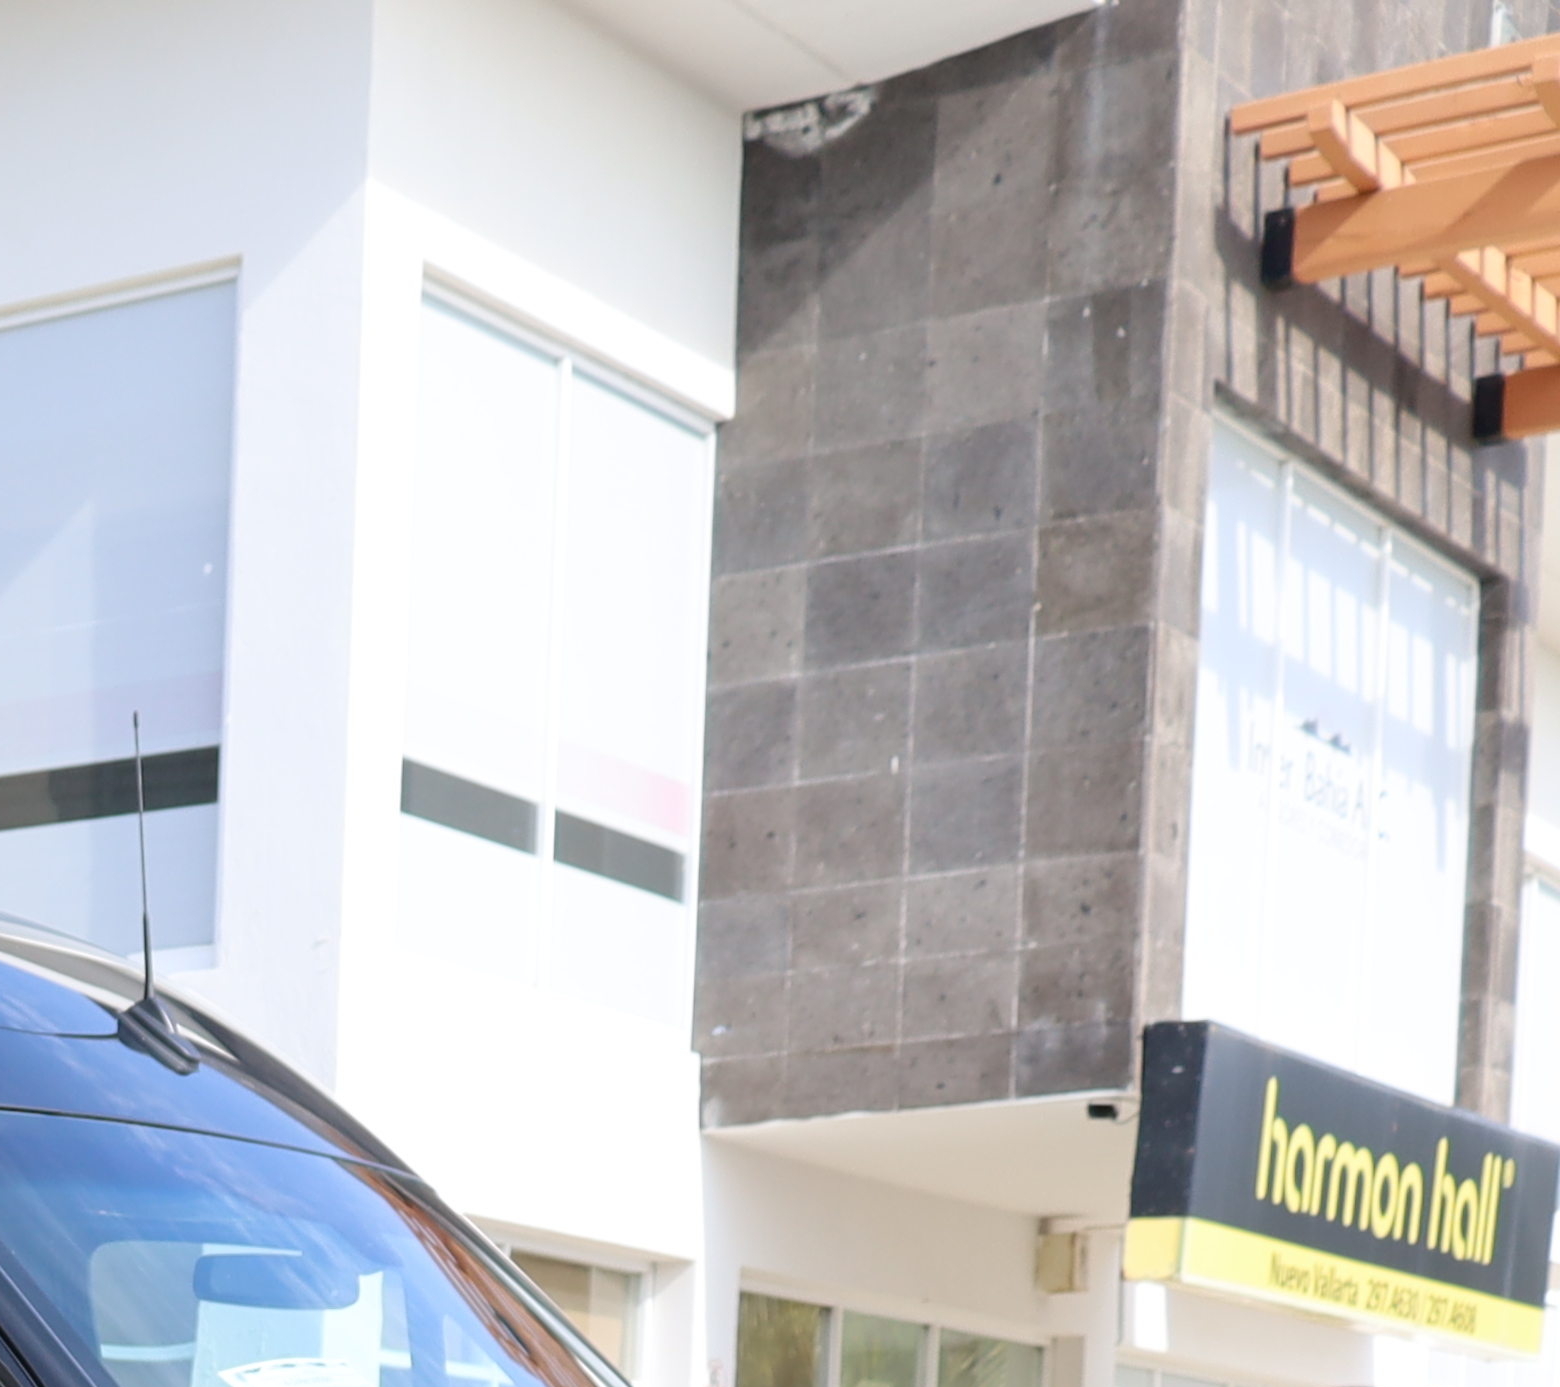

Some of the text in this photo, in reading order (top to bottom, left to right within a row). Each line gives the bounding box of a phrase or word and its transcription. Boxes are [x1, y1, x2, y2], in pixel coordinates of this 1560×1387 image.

[1255, 1075, 1503, 1266] harmon hall
[1270, 1250, 1310, 1294] Nuevo
[1313, 1262, 1359, 1307] Vallarta
